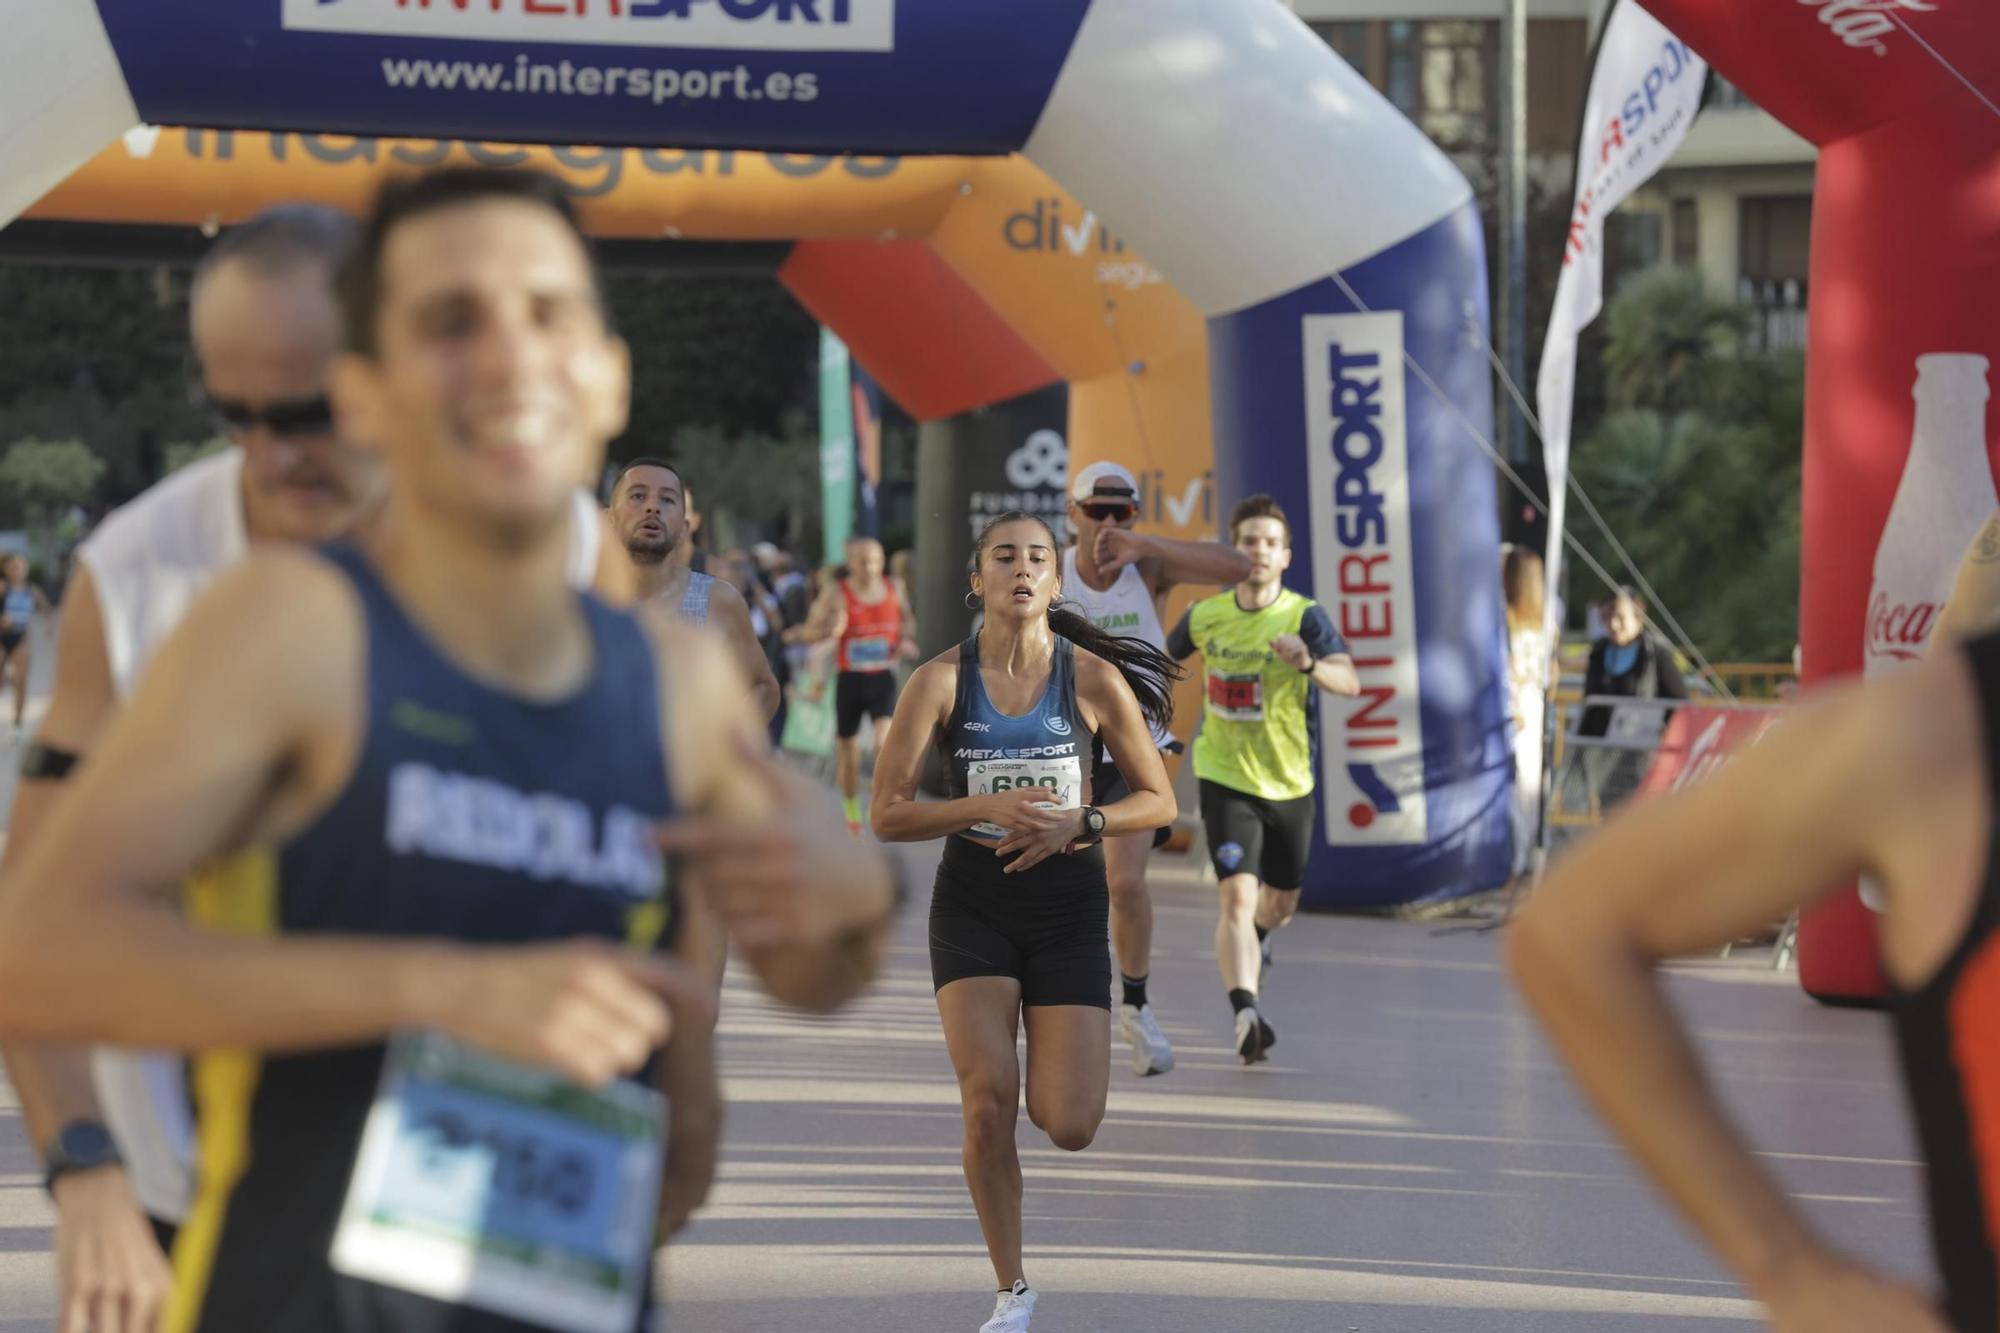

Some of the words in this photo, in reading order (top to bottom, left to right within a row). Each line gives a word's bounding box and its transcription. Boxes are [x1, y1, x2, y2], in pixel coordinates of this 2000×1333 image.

[381, 54, 819, 104] www.intersport.es
[1328, 343, 1399, 748] INTERSPORT
[963, 721, 992, 732] 42K
